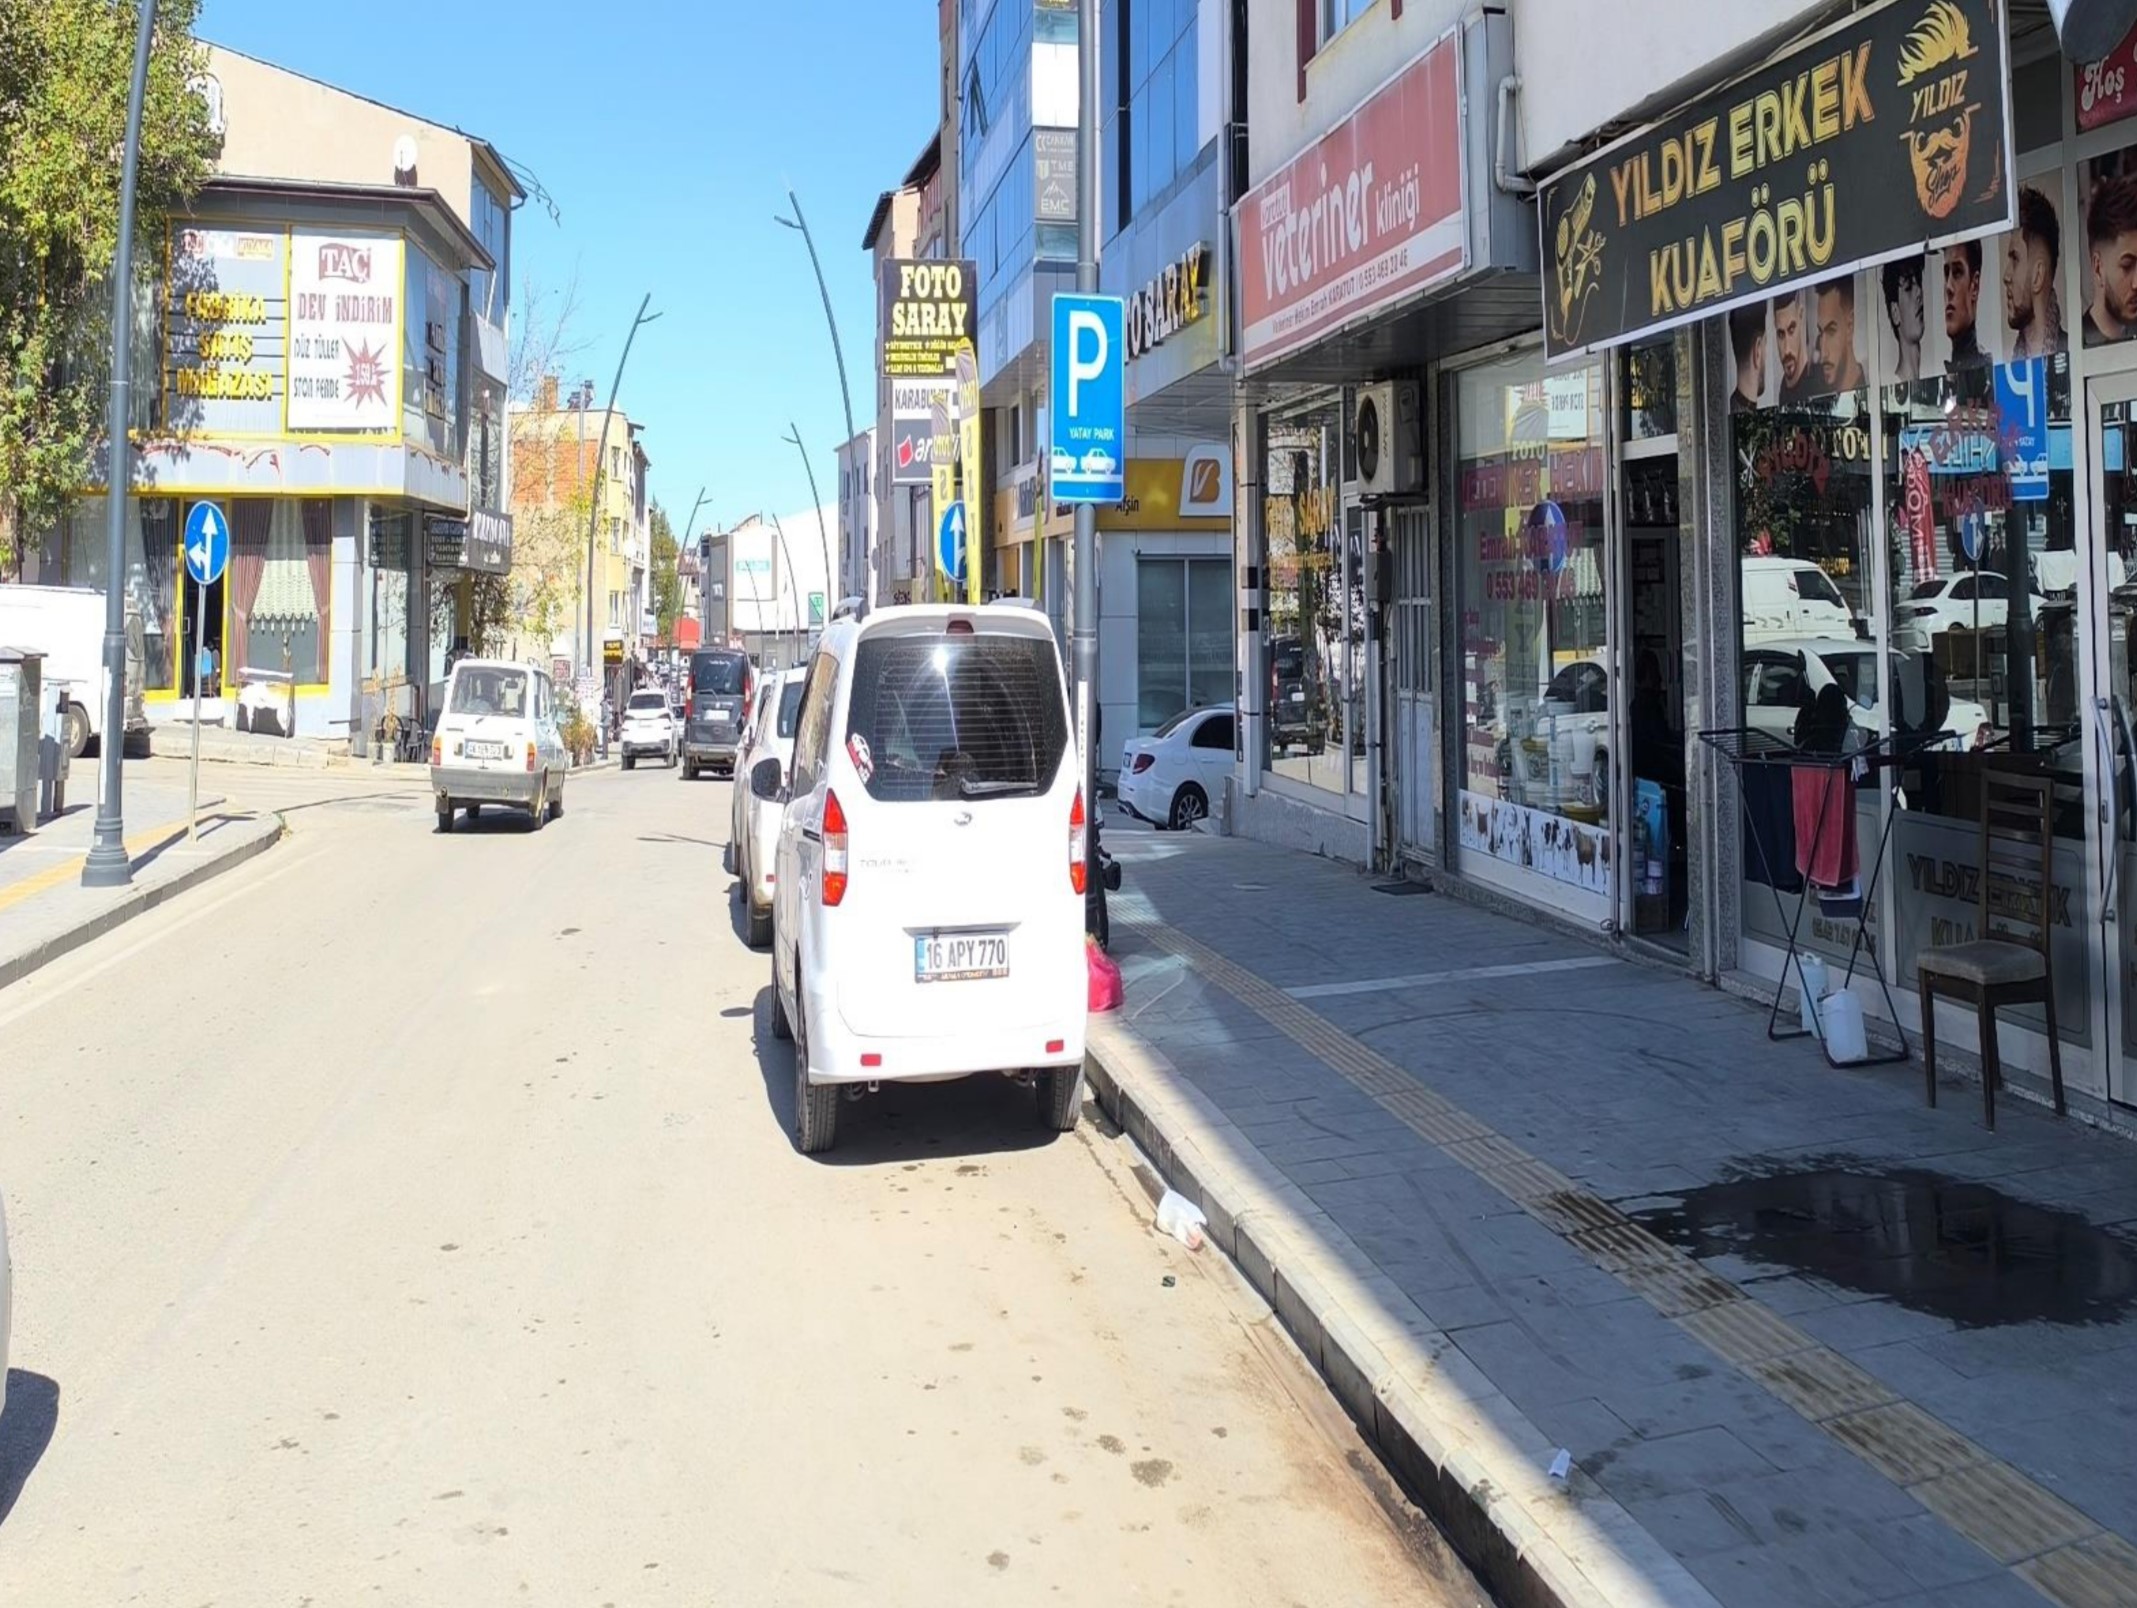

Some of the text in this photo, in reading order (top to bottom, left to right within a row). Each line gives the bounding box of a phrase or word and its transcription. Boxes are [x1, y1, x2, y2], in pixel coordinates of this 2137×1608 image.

[1909, 69, 1968, 124] YILDIZ
[2081, 55, 2124, 112] Hoş
[1609, 40, 1875, 227] YILDIZ ERKEK
[1262, 162, 1420, 302] veteriner kliniği
[1650, 159, 1837, 317] KUAFÖRÜ
[320, 248, 371, 283] TAÇ
[900, 265, 962, 298] FOTO
[297, 292, 326, 323] DEV
[1144, 240, 1201, 350] SARAY
[892, 301, 967, 336] SARAY
[175, 364, 273, 400] MAĞAZASI
[1068, 310, 1108, 418] P
[895, 388, 950, 411] KARABUT
[1069, 427, 1115, 441] YATAY PARK
[1907, 852, 1980, 905] YILDIZ
[927, 938, 1006, 970] 16 APY 770
